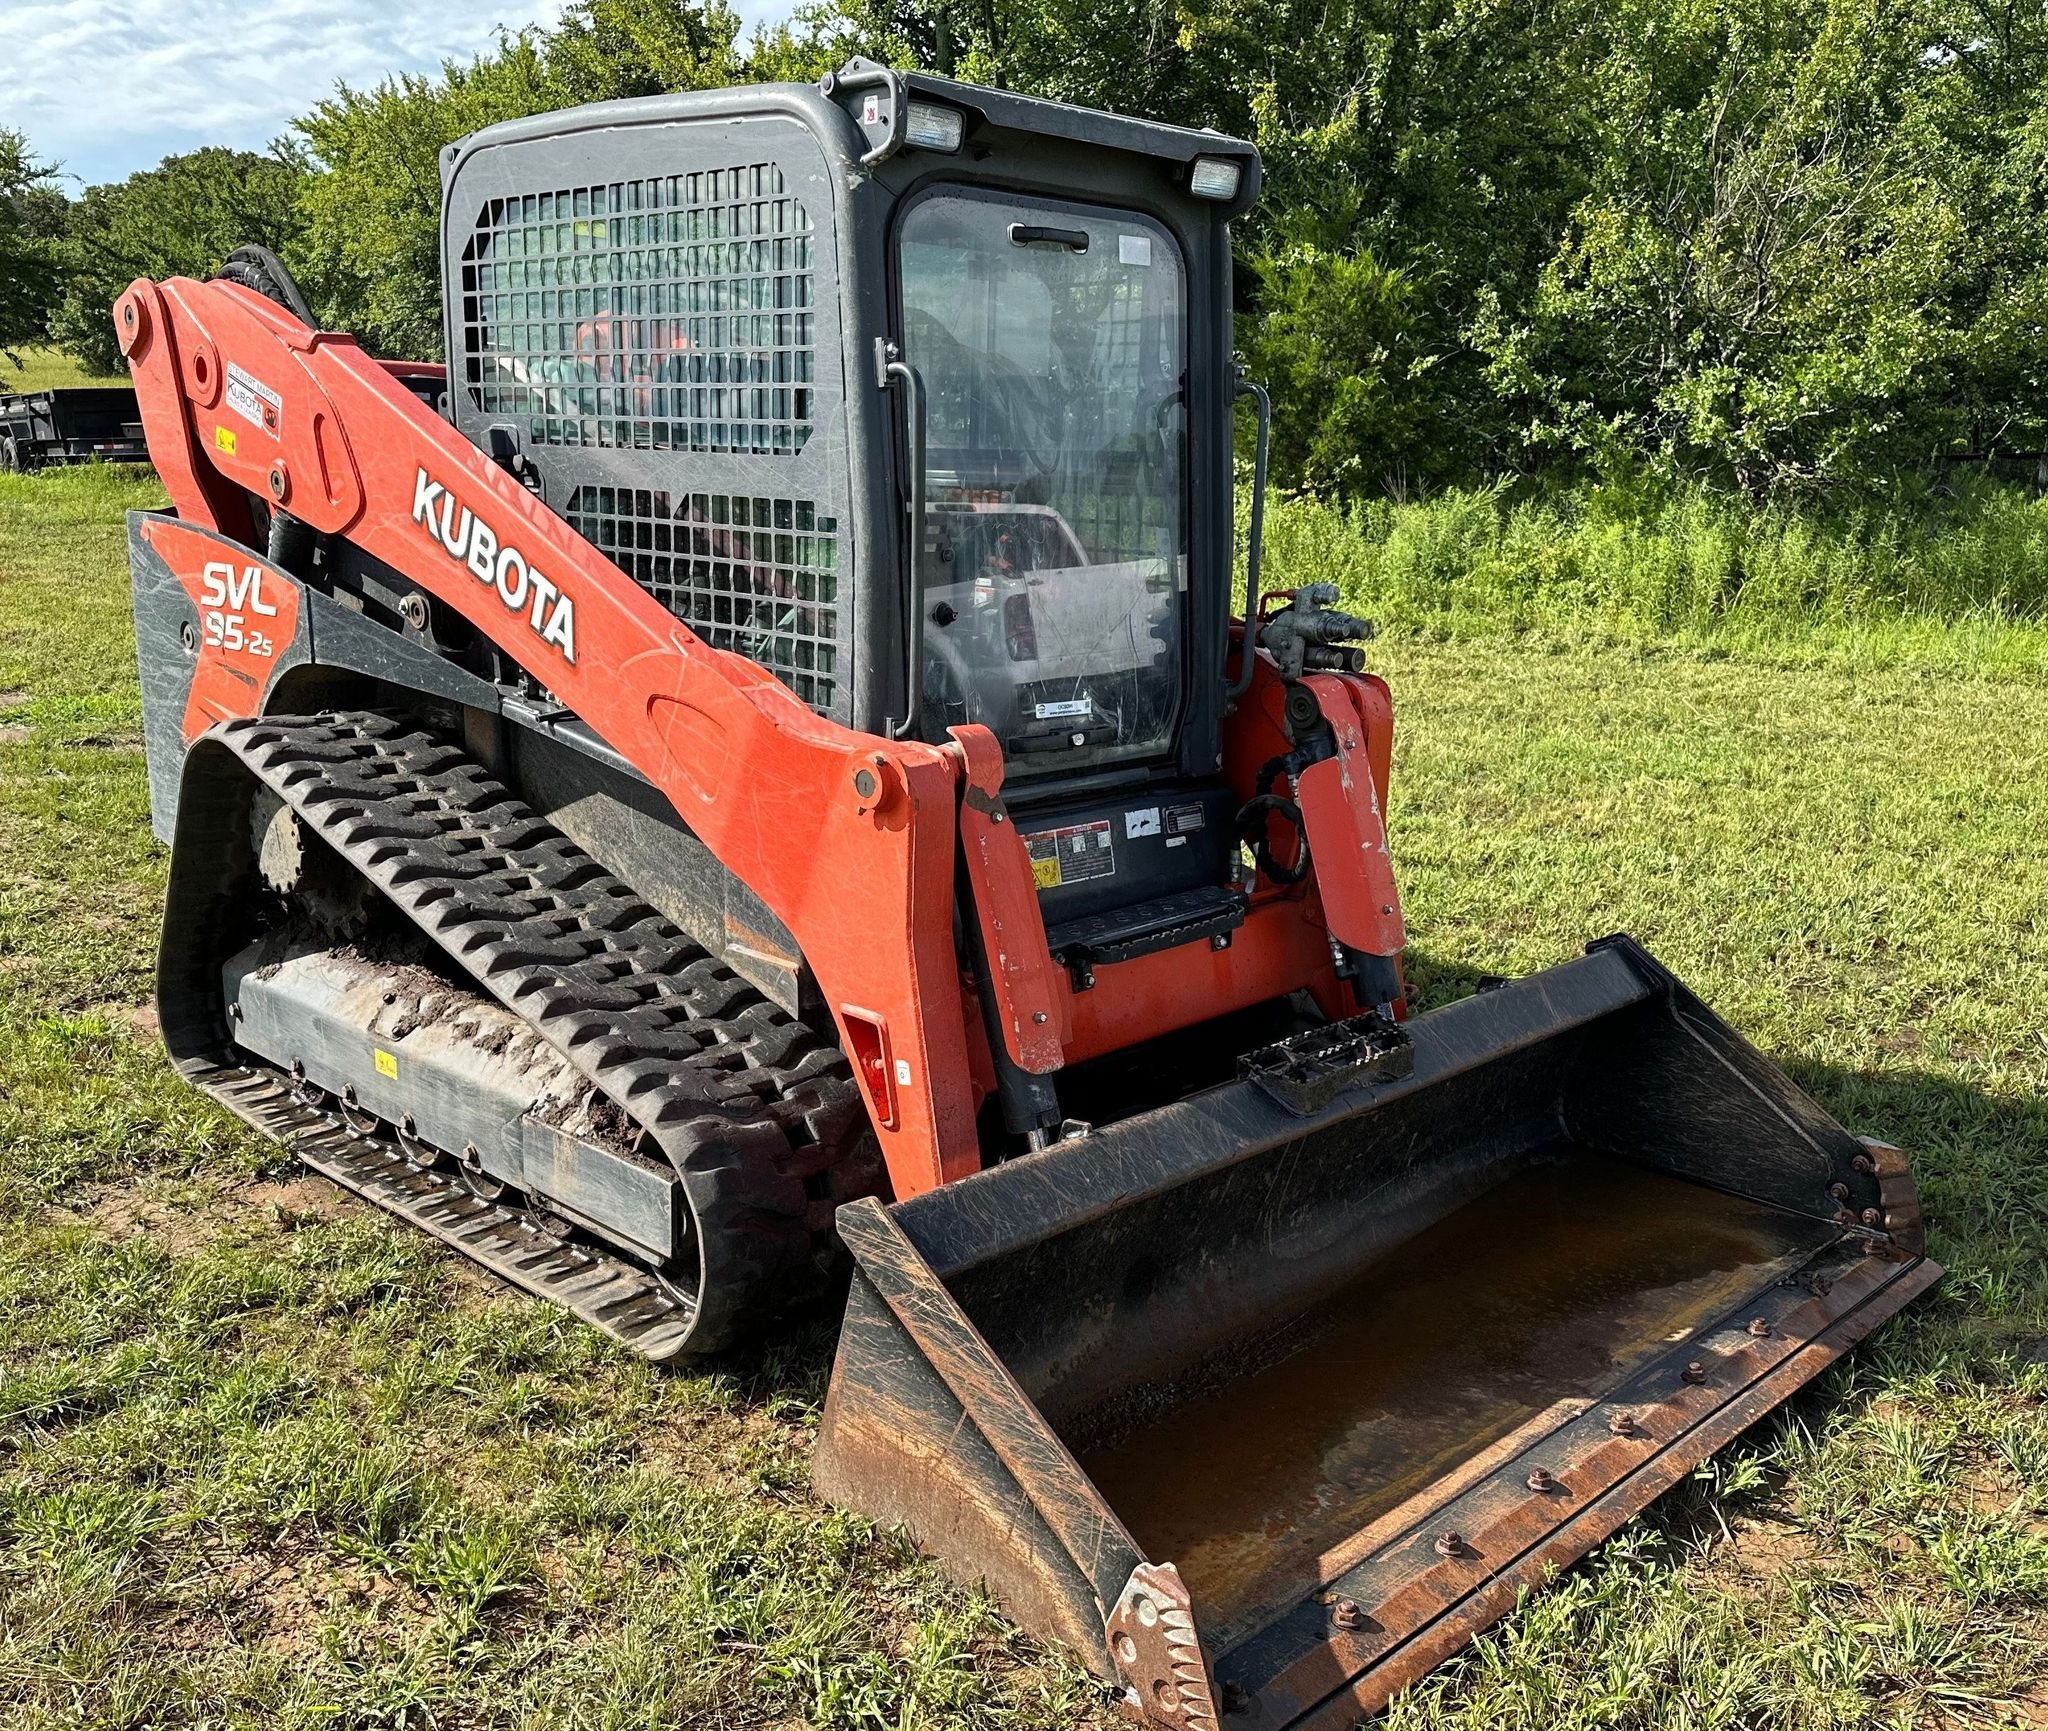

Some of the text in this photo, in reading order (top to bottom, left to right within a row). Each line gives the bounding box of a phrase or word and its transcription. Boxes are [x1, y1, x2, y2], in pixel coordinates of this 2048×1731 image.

[227, 380, 262, 414] KUBOTA
[201, 561, 277, 617] SVL
[412, 466, 577, 666] KUBOTA
